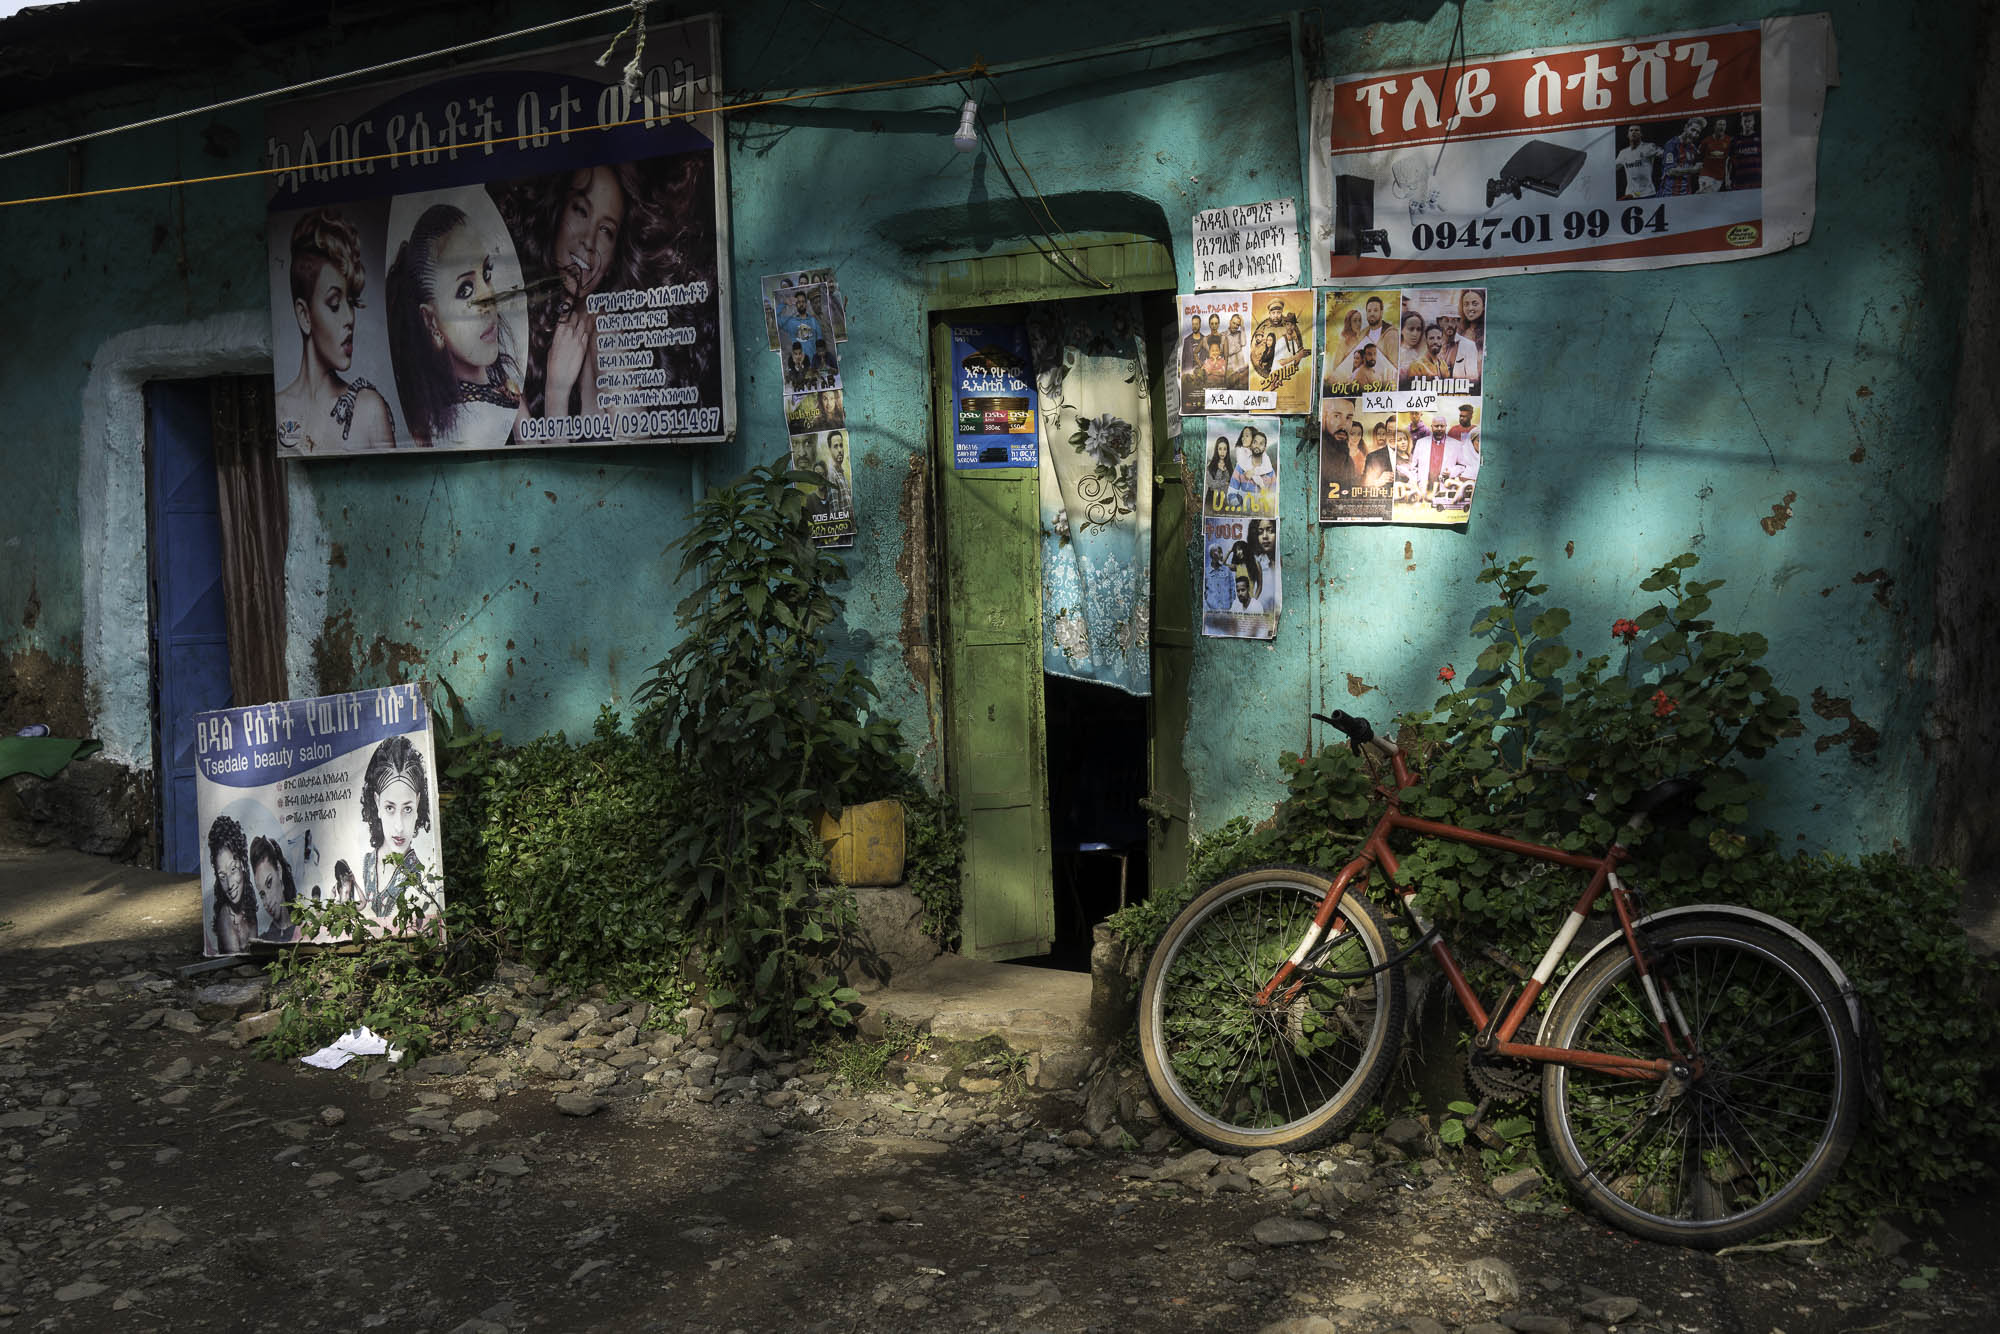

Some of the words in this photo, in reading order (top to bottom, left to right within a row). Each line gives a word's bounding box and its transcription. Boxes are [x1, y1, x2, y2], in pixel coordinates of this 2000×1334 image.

[1523, 41, 1718, 118] ስቴሽን
[516, 84, 582, 151] ቤተ
[1563, 208, 1609, 243] 99
[1621, 205, 1668, 235] 64
[1366, 396, 1393, 409] አዲስ
[1406, 395, 1436, 408] ፊልም
[829, 511, 849, 521] ALEM
[375, 683, 418, 725] ሳሎን
[203, 753, 249, 776] Tsedale
[254, 747, 294, 769] beauty
[299, 740, 332, 762] salon
